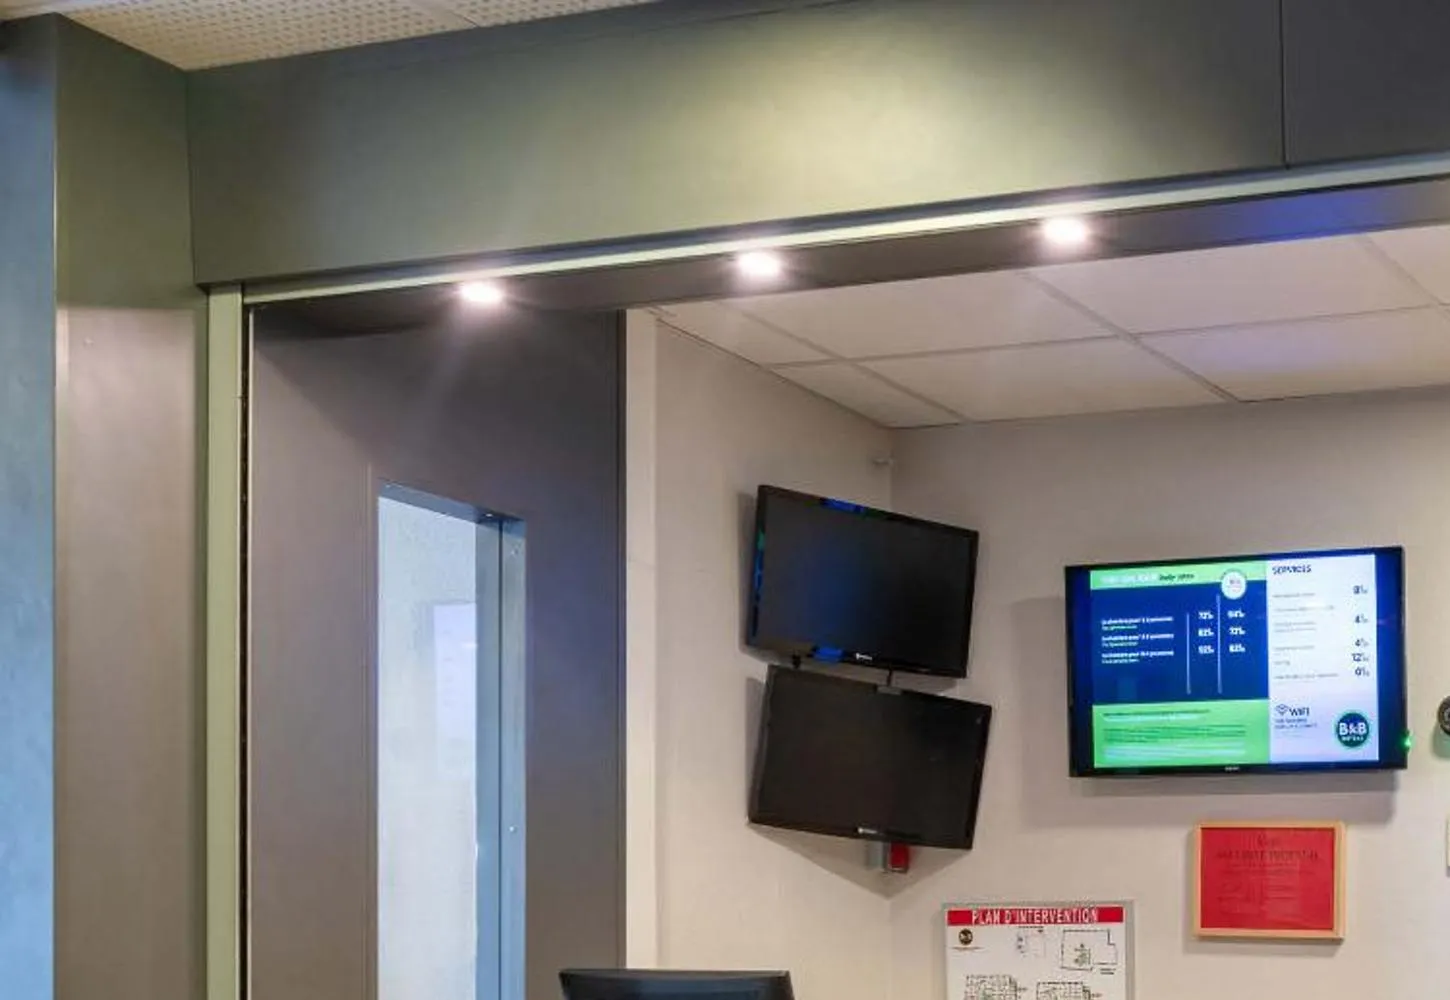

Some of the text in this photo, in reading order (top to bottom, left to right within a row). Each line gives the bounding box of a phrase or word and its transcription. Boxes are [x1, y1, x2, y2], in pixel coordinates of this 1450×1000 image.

[1339, 721, 1367, 736] B&B
[971, 907, 1099, 925] PLAN D'INTERVENTION
